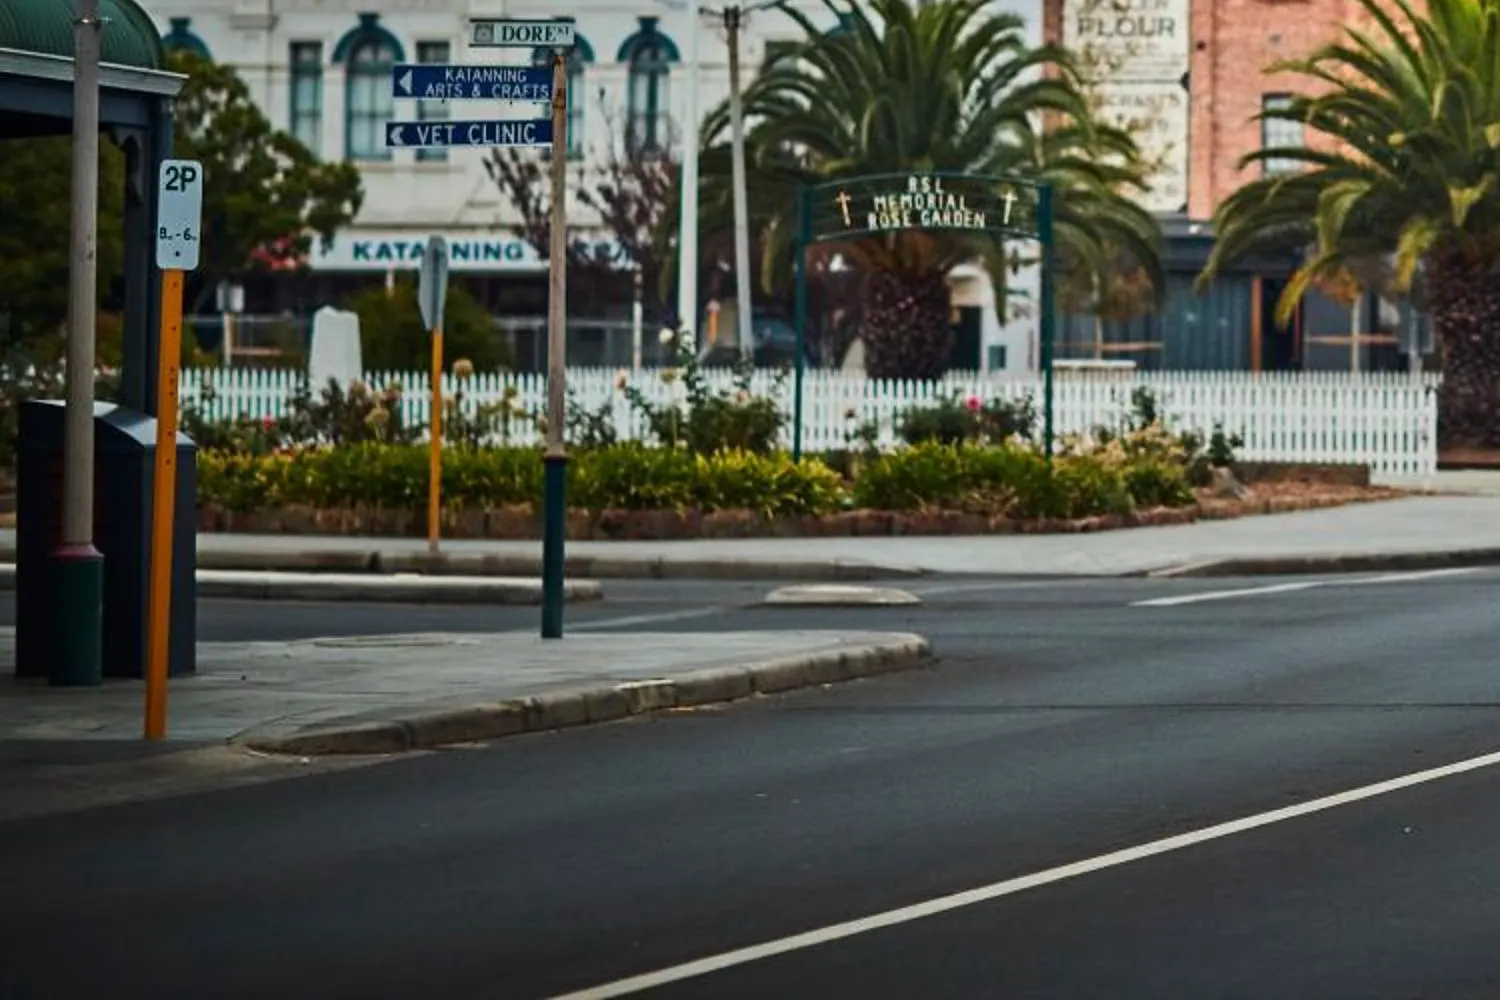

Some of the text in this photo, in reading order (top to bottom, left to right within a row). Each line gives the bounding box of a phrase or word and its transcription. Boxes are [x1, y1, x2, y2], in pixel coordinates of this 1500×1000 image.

[502, 25, 557, 43] DORE
[1077, 16, 1176, 38] FLOUR
[444, 68, 528, 84] KATANNING
[424, 83, 549, 98] ARTS & CRAFTS
[416, 124, 537, 145] VET CLINIC
[164, 165, 197, 192] 2P
[908, 175, 944, 194] RSL
[873, 194, 967, 212] MEMORIAL
[867, 208, 986, 231] ROSE GARDEN
[352, 241, 525, 261] KATANING
